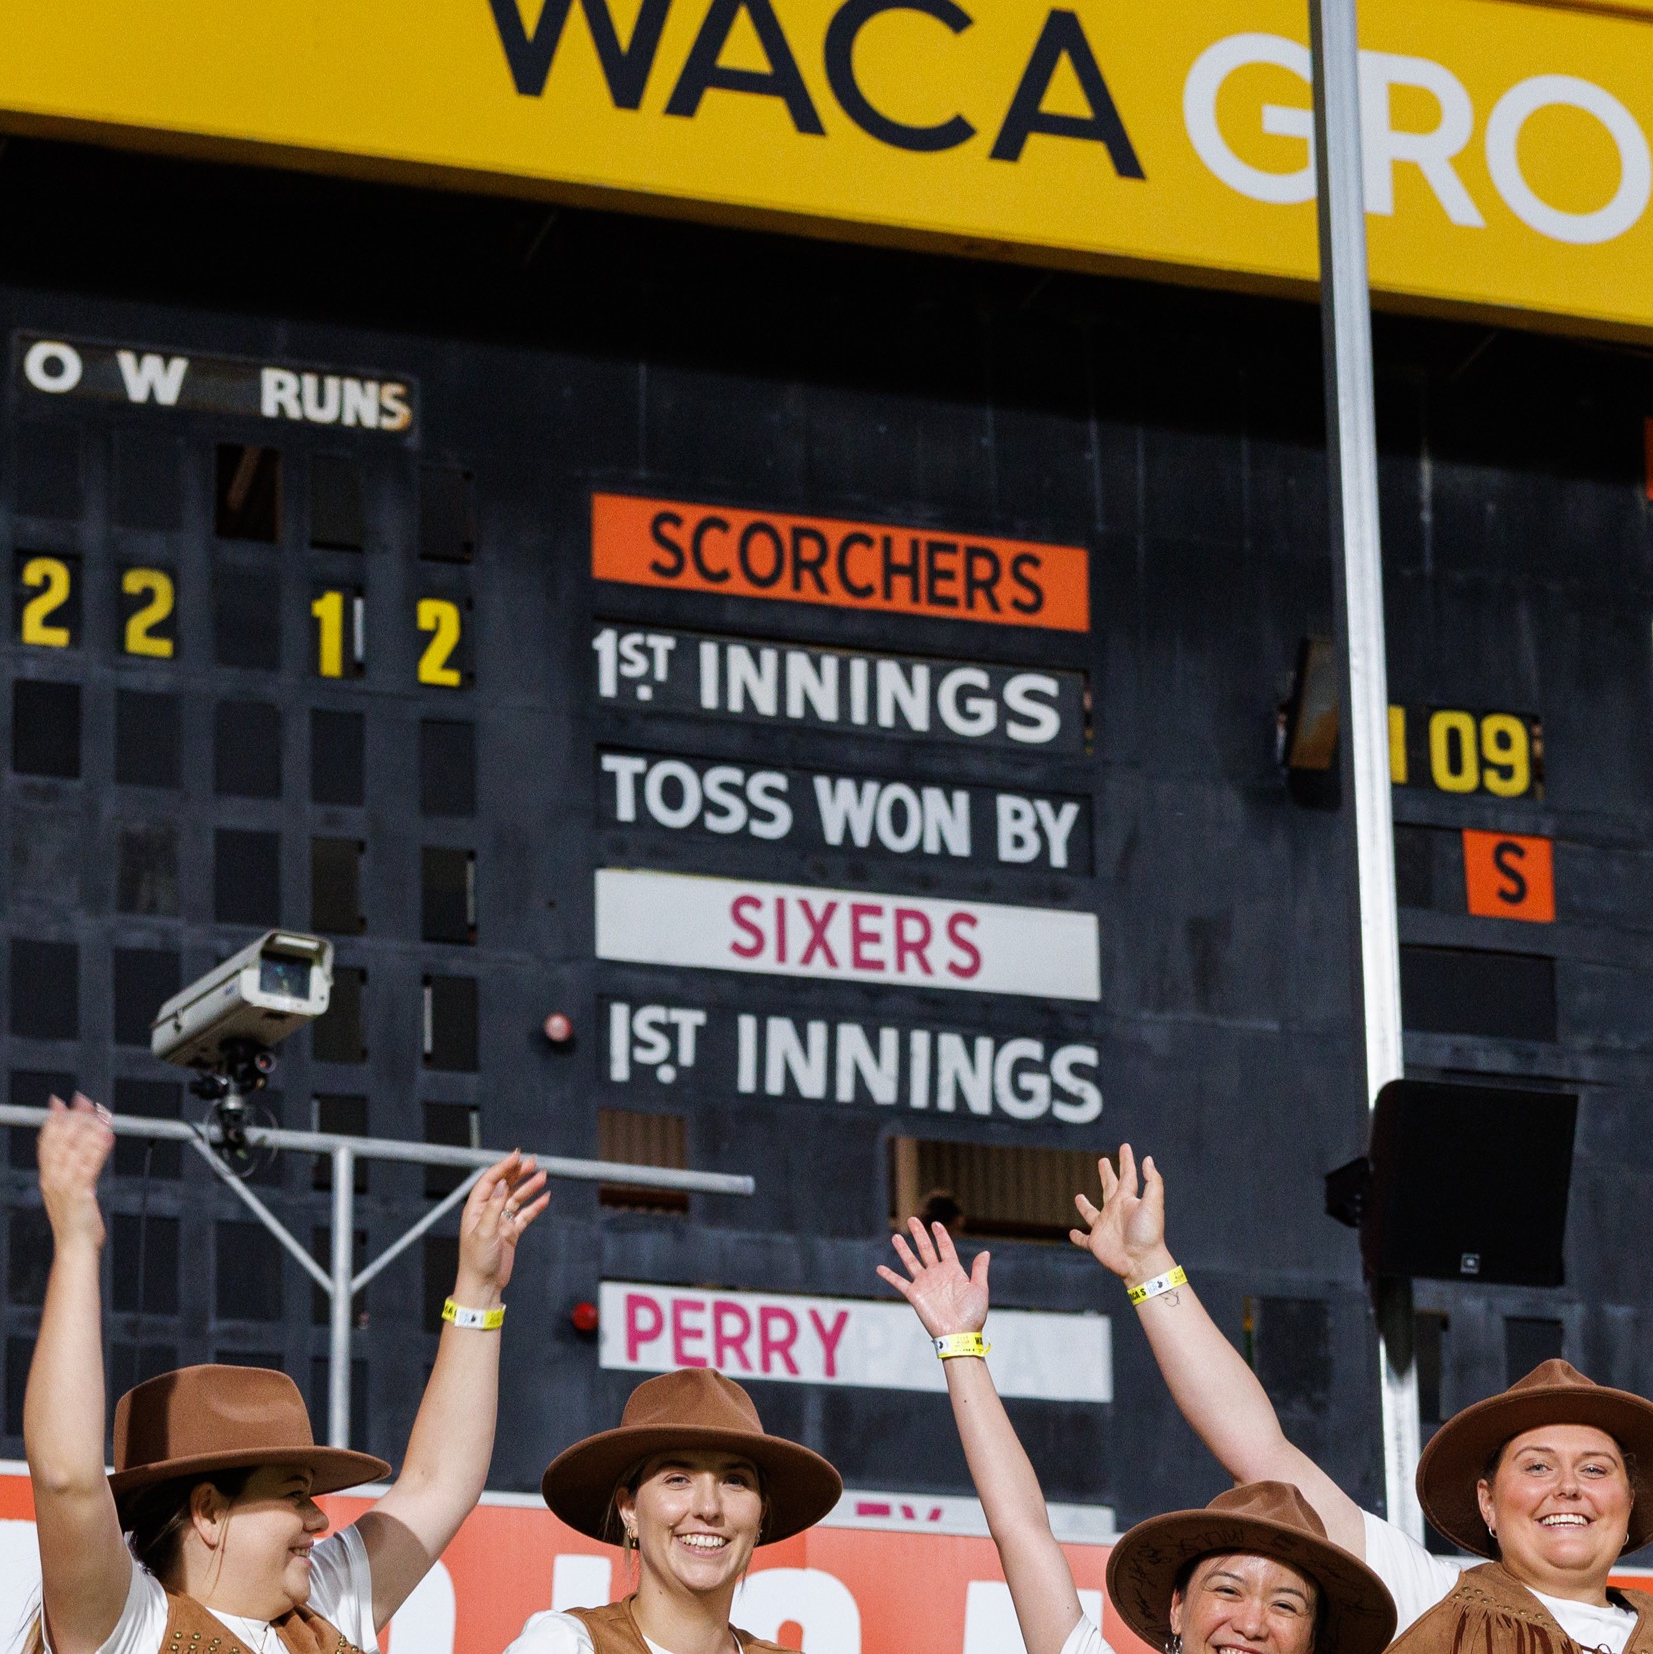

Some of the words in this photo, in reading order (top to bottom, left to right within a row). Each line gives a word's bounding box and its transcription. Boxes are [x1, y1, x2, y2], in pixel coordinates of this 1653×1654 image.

[487, 0, 1147, 181] WACA
[25, 342, 83, 392] O
[116, 350, 188, 405] W
[261, 367, 412, 431] RUNS
[22, 558, 70, 647] 2
[123, 568, 174, 658] 2
[650, 511, 1043, 615] SCORCHERS
[700, 641, 1060, 743] INNINGS
[602, 754, 792, 839] TOSS
[814, 776, 970, 857] WON
[997, 794, 1079, 868] BY
[1493, 840, 1527, 905] S
[730, 896, 981, 979] SIXERS
[738, 1014, 1103, 1124] INNINGS
[625, 1294, 849, 1378] PERRY
